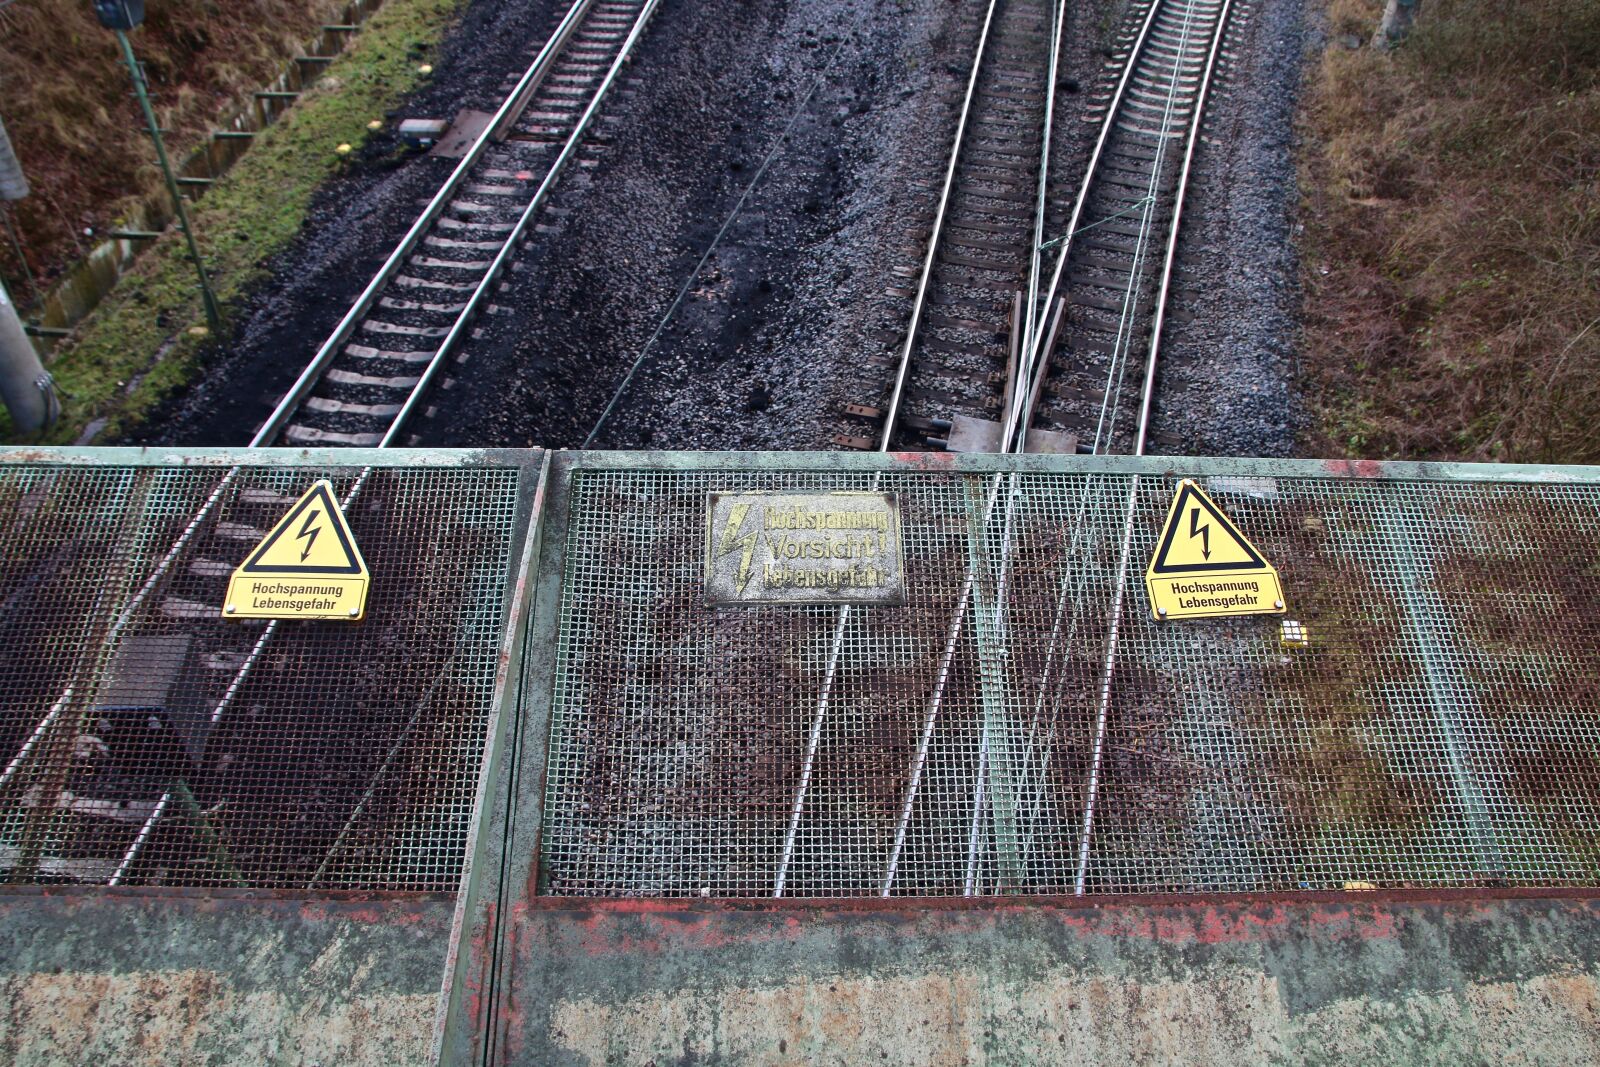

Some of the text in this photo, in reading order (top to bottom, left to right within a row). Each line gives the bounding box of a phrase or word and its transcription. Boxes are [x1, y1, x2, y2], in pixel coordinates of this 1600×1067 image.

[252, 583, 343, 597] Hochspannung
[1171, 581, 1259, 595] Hochspannung
[252, 597, 336, 611] Lebensgefahr
[1178, 594, 1258, 609] Lebensgefahr
